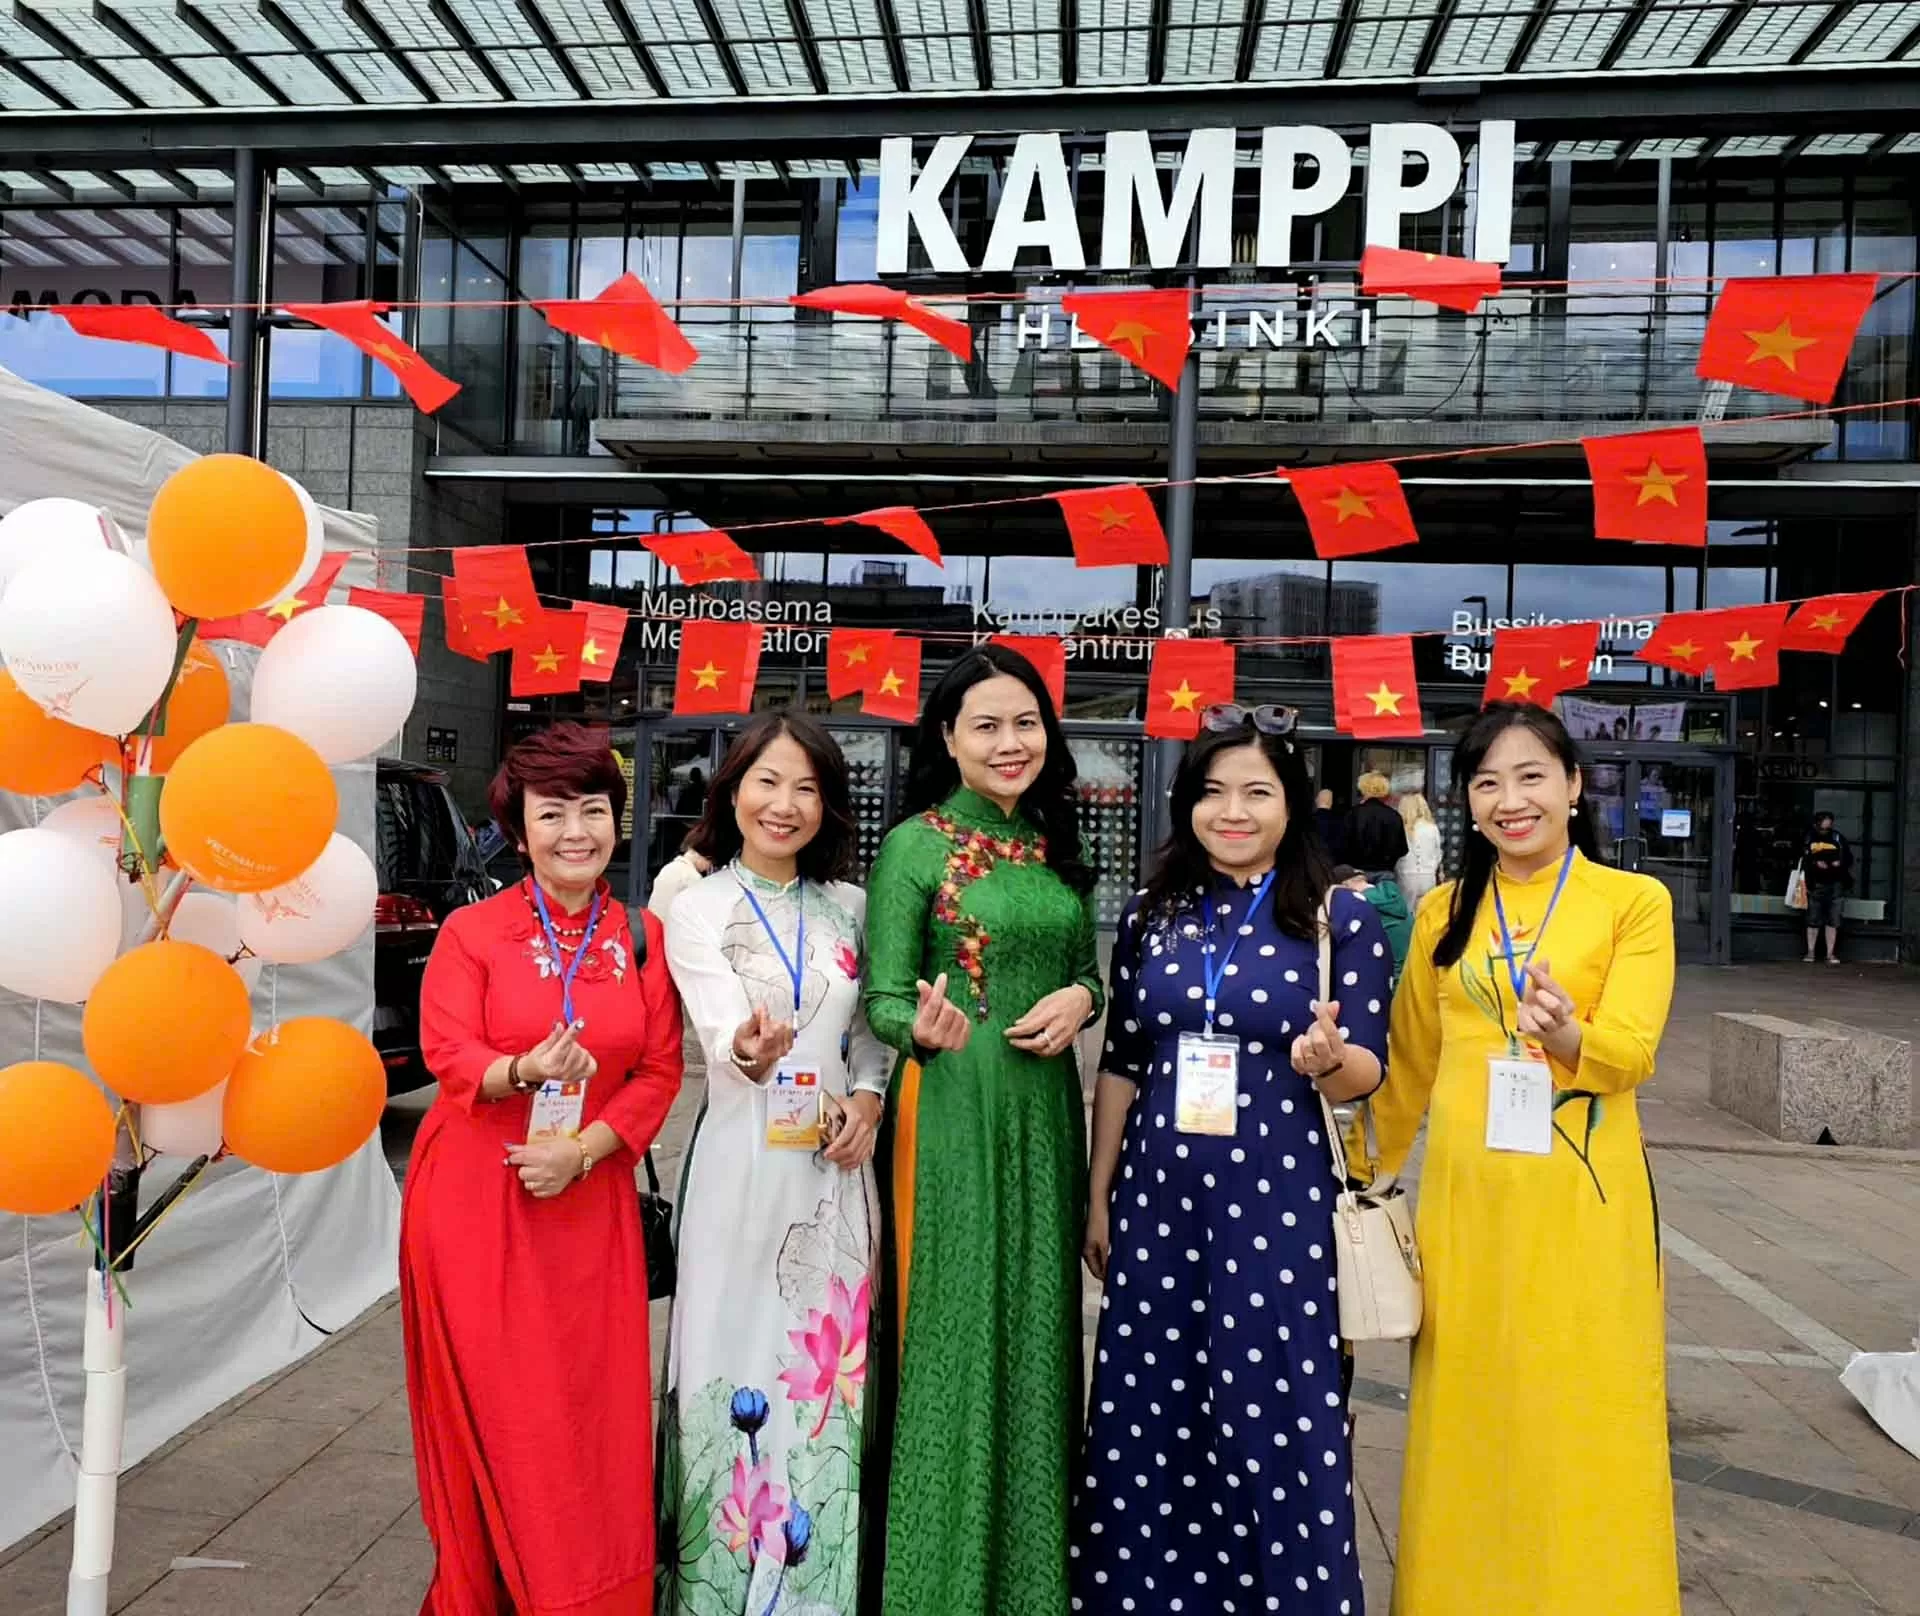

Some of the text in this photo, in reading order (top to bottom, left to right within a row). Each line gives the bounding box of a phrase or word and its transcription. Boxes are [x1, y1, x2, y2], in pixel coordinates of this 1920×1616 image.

[877, 119, 1515, 273] KAMPPI
[1017, 307, 1371, 350] HEINKI
[641, 591, 832, 623] Metroasema
[973, 601, 1222, 634] Kauppakesus
[641, 621, 831, 653] Meation
